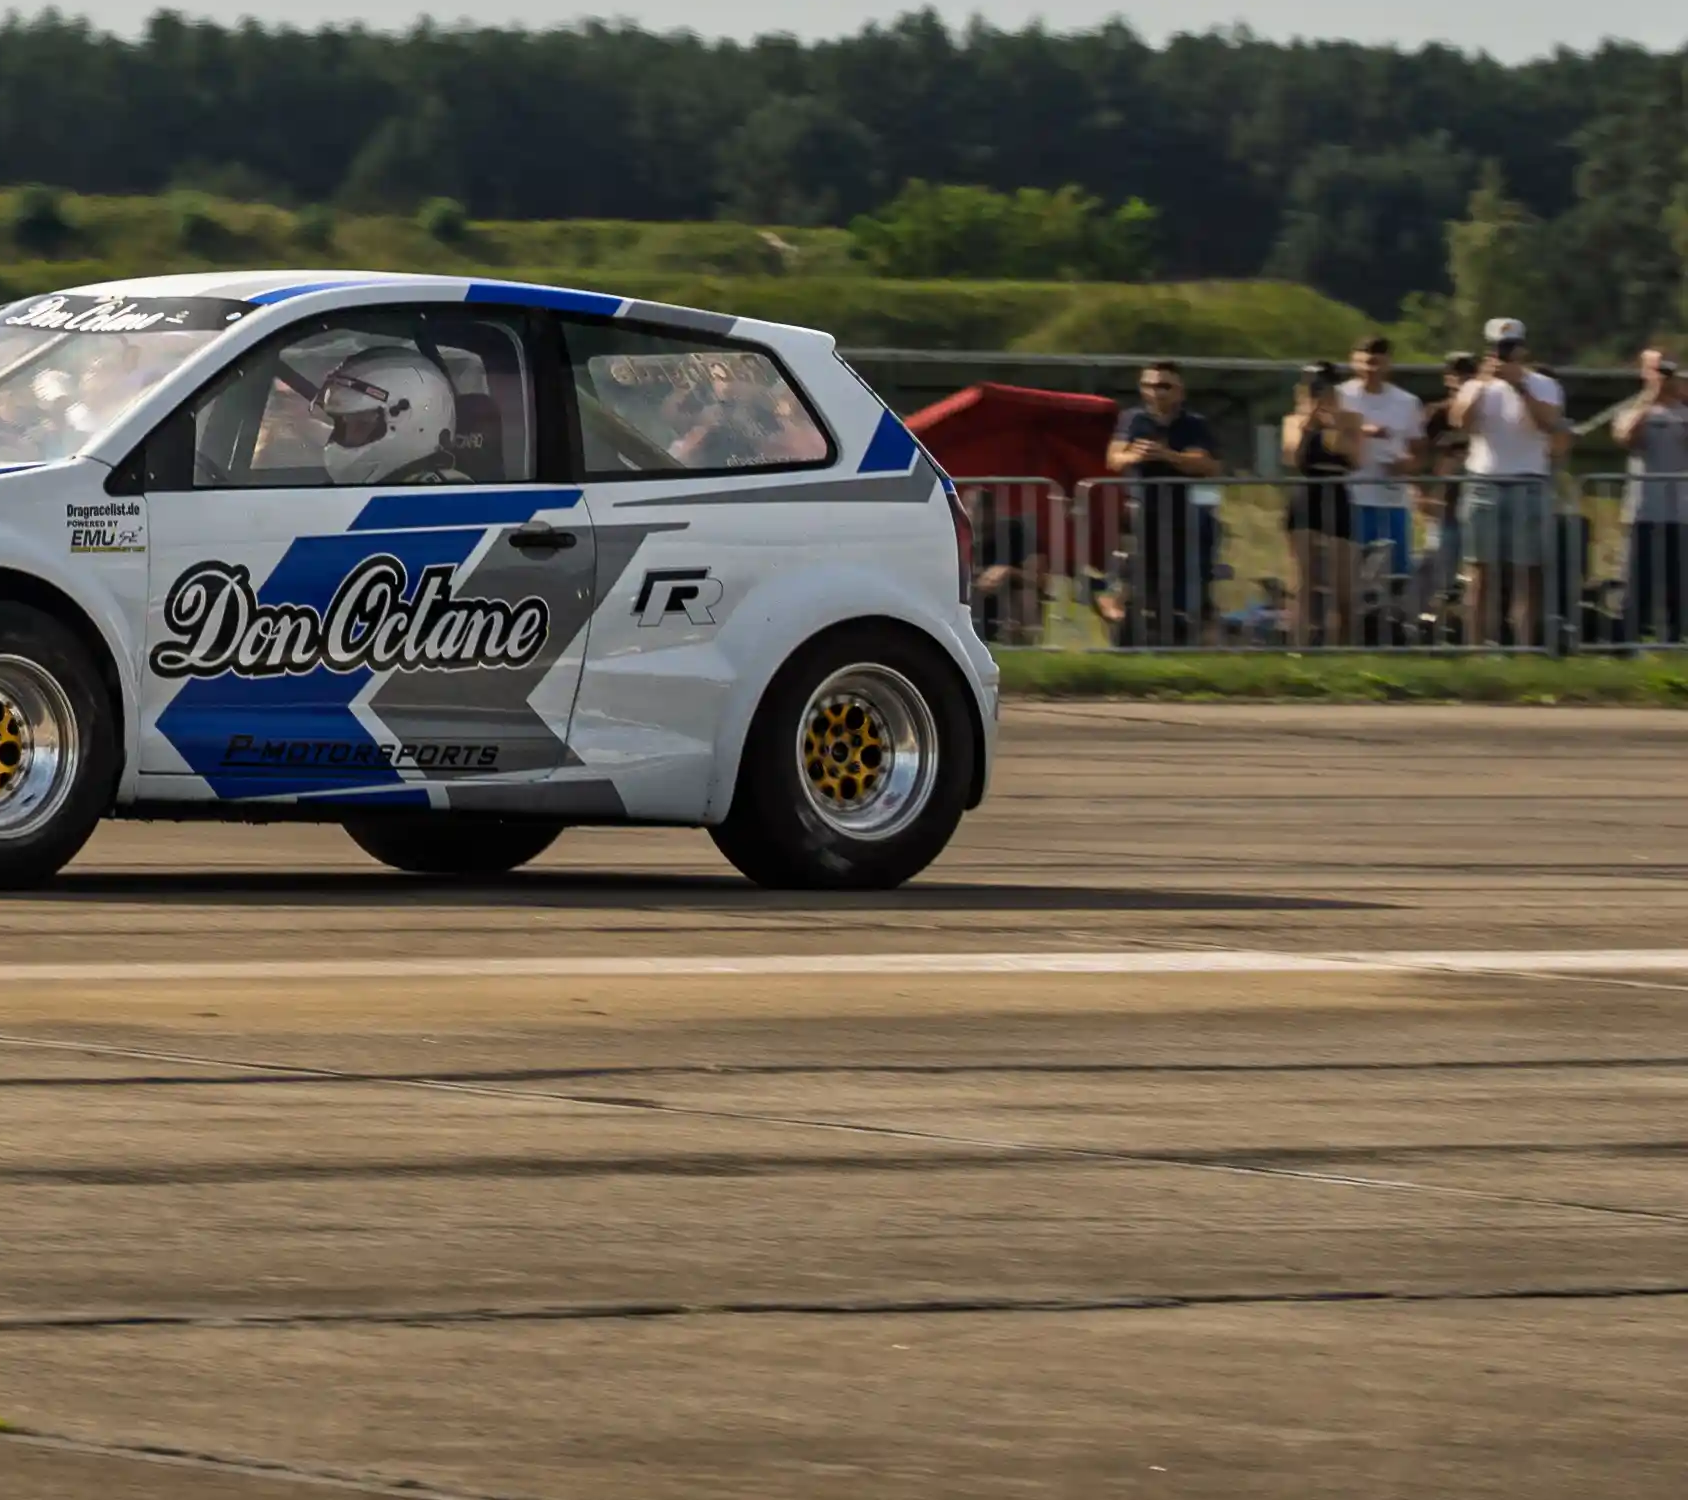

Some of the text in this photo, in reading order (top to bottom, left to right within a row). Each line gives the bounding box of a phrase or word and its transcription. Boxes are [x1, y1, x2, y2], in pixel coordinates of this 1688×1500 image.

[66, 503, 140, 519] Dragracelist.de
[66, 520, 118, 528] POWERED BY
[71, 530, 115, 546] EMU
[150, 553, 549, 678] Don Octane
[224, 734, 500, 766] P-MOTORSPORTS
